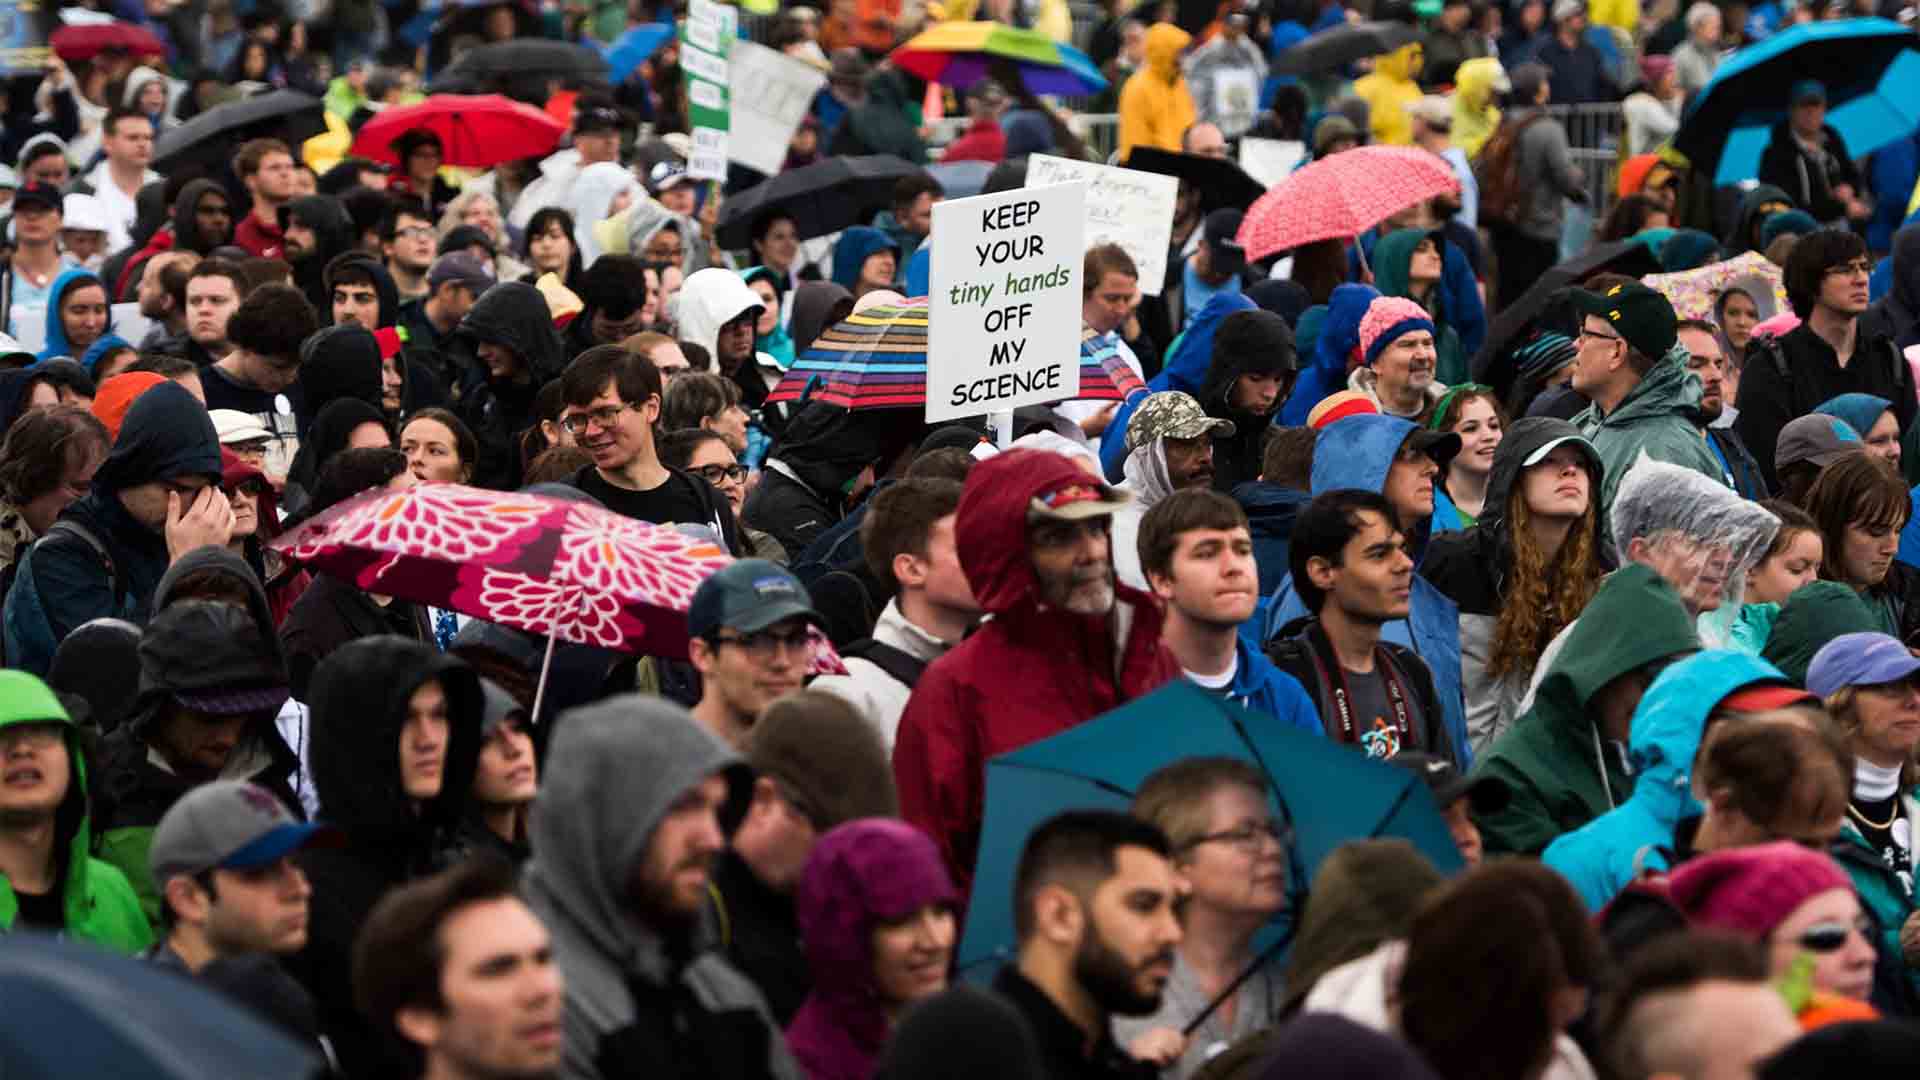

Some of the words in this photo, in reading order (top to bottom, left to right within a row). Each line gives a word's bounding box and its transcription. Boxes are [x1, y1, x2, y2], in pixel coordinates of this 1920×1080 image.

[982, 200, 1041, 233] KEEP
[975, 234, 1045, 267] YOUR
[949, 281, 995, 307] tiny
[1004, 264, 1071, 296] hands
[983, 303, 1033, 334] OFF
[988, 337, 1027, 367] MY
[949, 363, 1062, 407] SCIENCE
